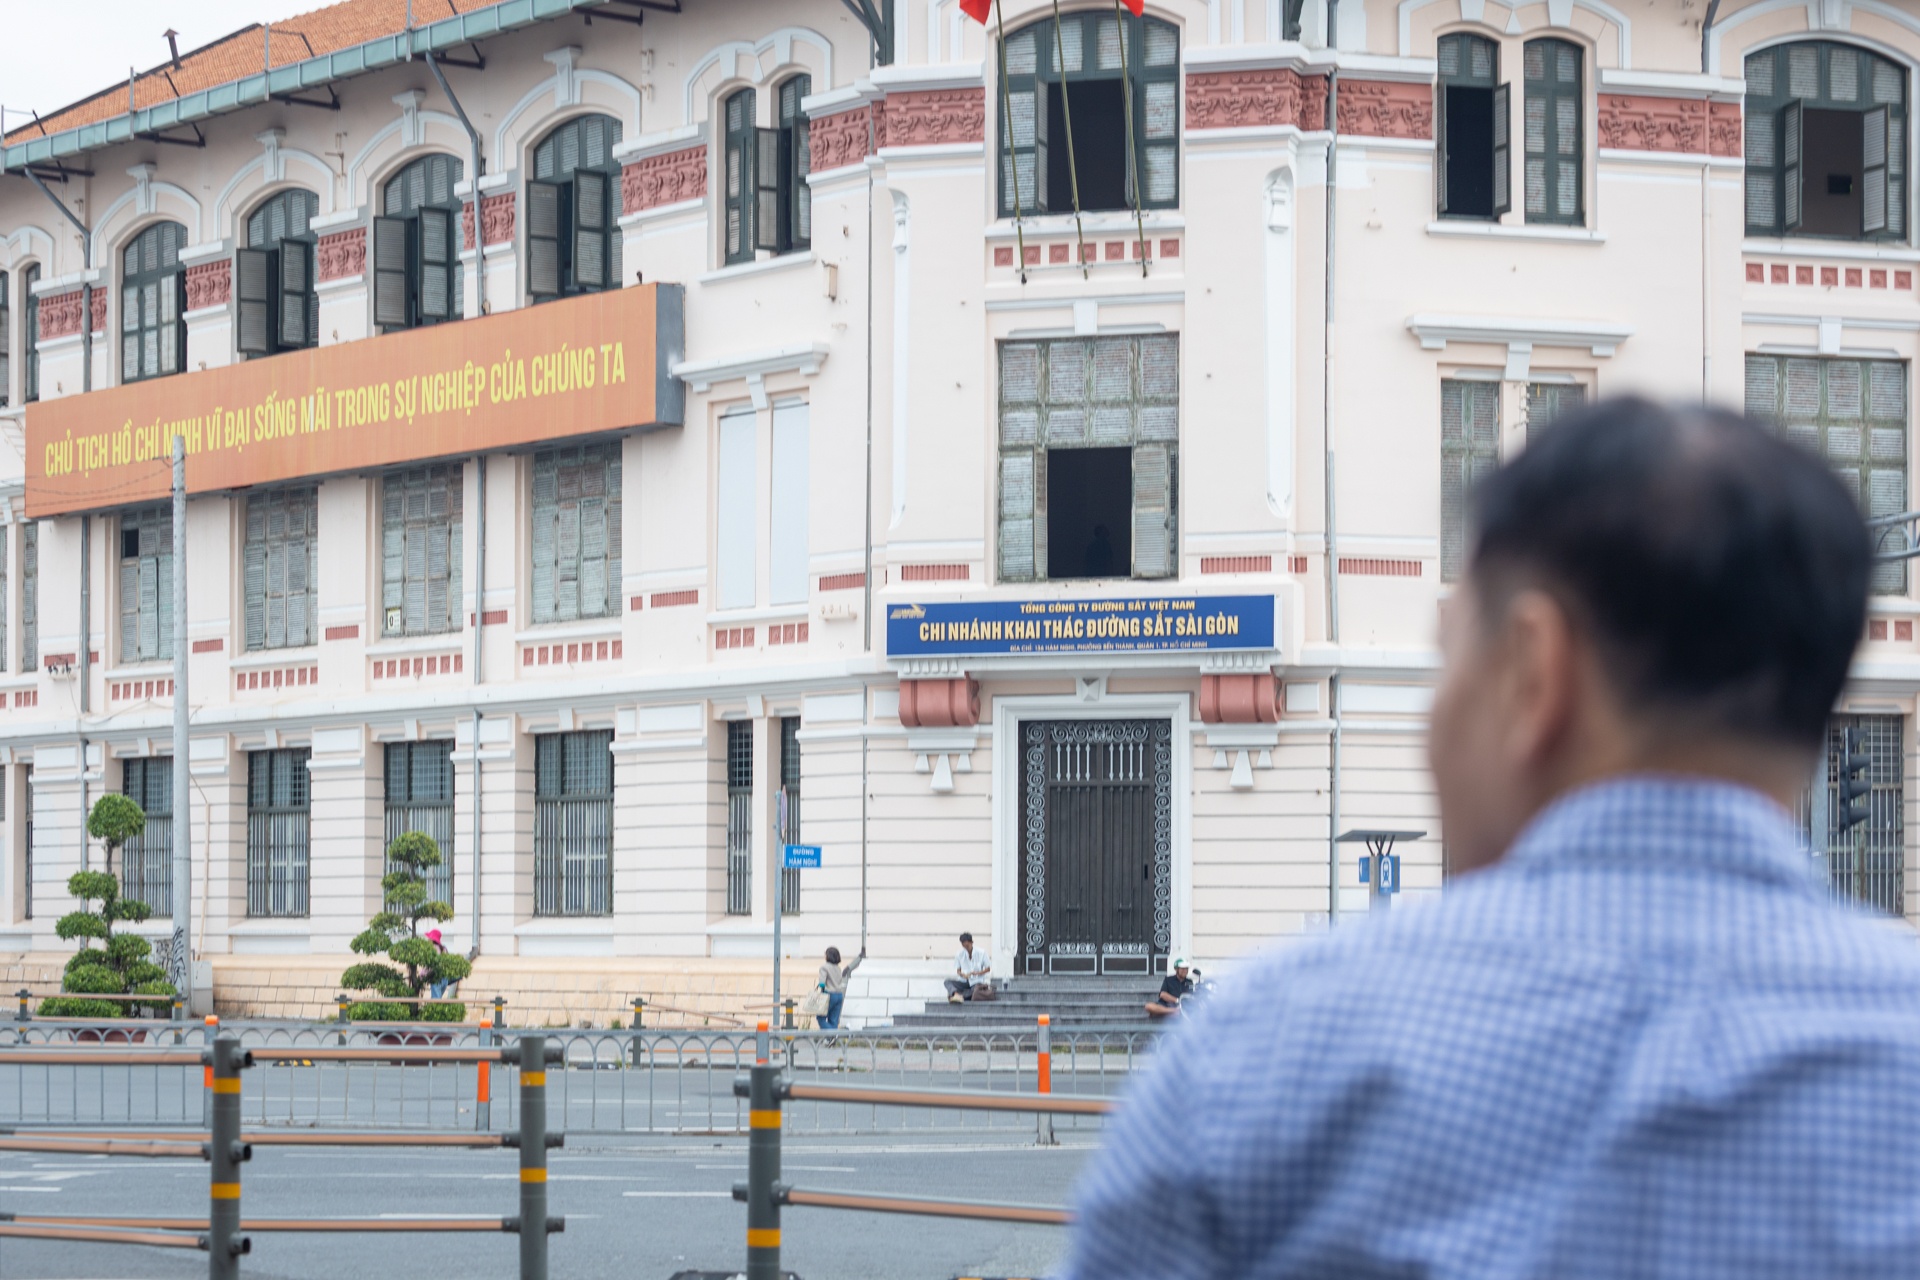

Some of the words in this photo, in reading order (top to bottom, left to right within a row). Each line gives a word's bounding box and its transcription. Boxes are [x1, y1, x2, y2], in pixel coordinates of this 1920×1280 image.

[45, 428, 73, 478] CHỦ
[77, 433, 108, 479] TỊCH
[112, 418, 133, 467] HỒ
[135, 416, 161, 463] CHÍ
[206, 406, 223, 452] VĨ
[224, 406, 251, 453] ĐẠI
[254, 390, 296, 442] SỐNG
[300, 386, 331, 434] MÃI
[335, 382, 390, 429] TRONG
[394, 375, 418, 425] SỰ
[421, 360, 486, 416] NGHIỆP
[490, 348, 527, 404] CỦA
[531, 342, 596, 397] CHÚNG
[600, 341, 626, 386] TA
[1020, 601, 1045, 613] TỔNG
[1049, 602, 1076, 613] CÔNG
[1078, 602, 1089, 612] TY
[1091, 600, 1125, 612] ĐƯỜNG
[1128, 599, 1147, 612] SẮT
[1149, 599, 1170, 612] VIỆT
[1172, 600, 1196, 611] NAM
[919, 622, 946, 642] CHI
[948, 617, 1001, 641] NHÁNH
[1004, 620, 1041, 640] KHAI
[1043, 615, 1084, 639] THÁC
[1086, 613, 1140, 638] ĐƯỜNG
[1143, 610, 1174, 637] SẮT
[1176, 612, 1203, 636] SÀI
[1205, 611, 1239, 636] GÒN
